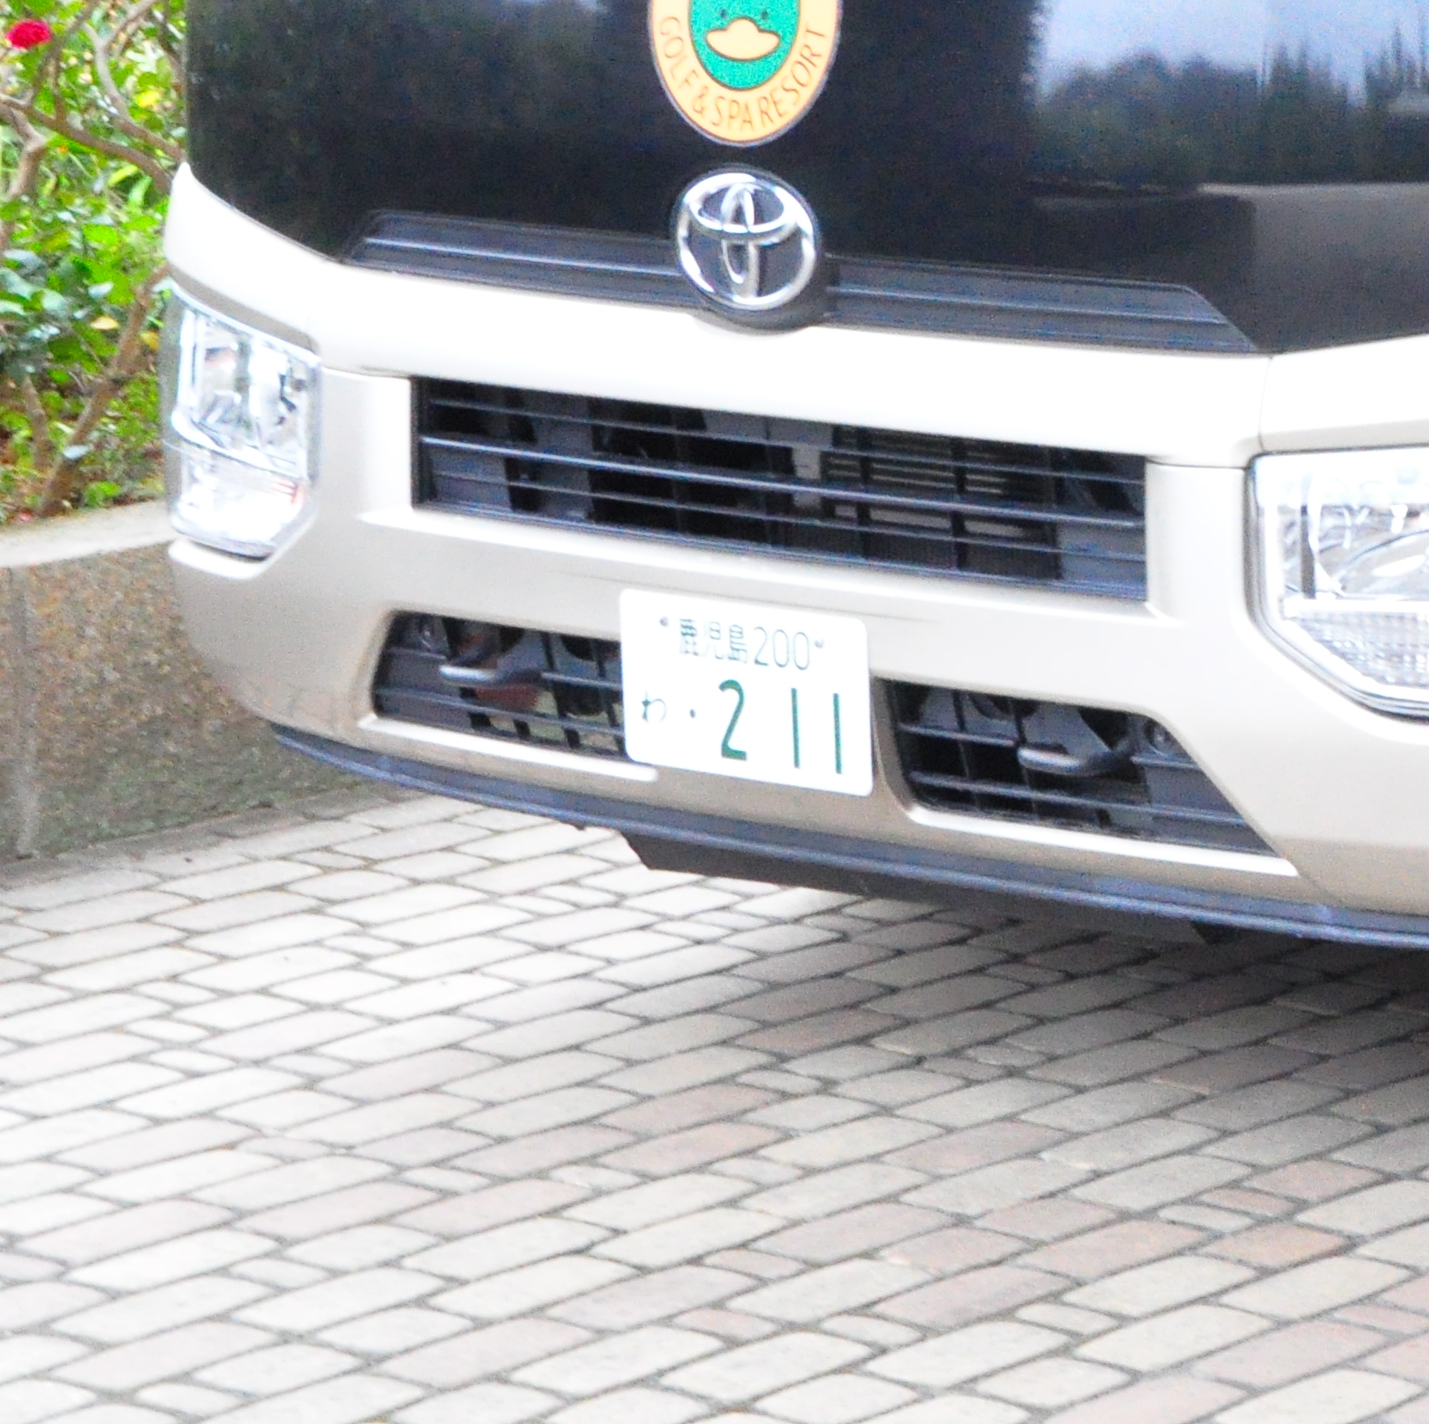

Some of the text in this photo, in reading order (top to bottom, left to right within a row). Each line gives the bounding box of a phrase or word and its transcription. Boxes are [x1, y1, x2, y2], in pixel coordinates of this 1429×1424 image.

[660, 16, 827, 133] GOLF & SPA RESORT
